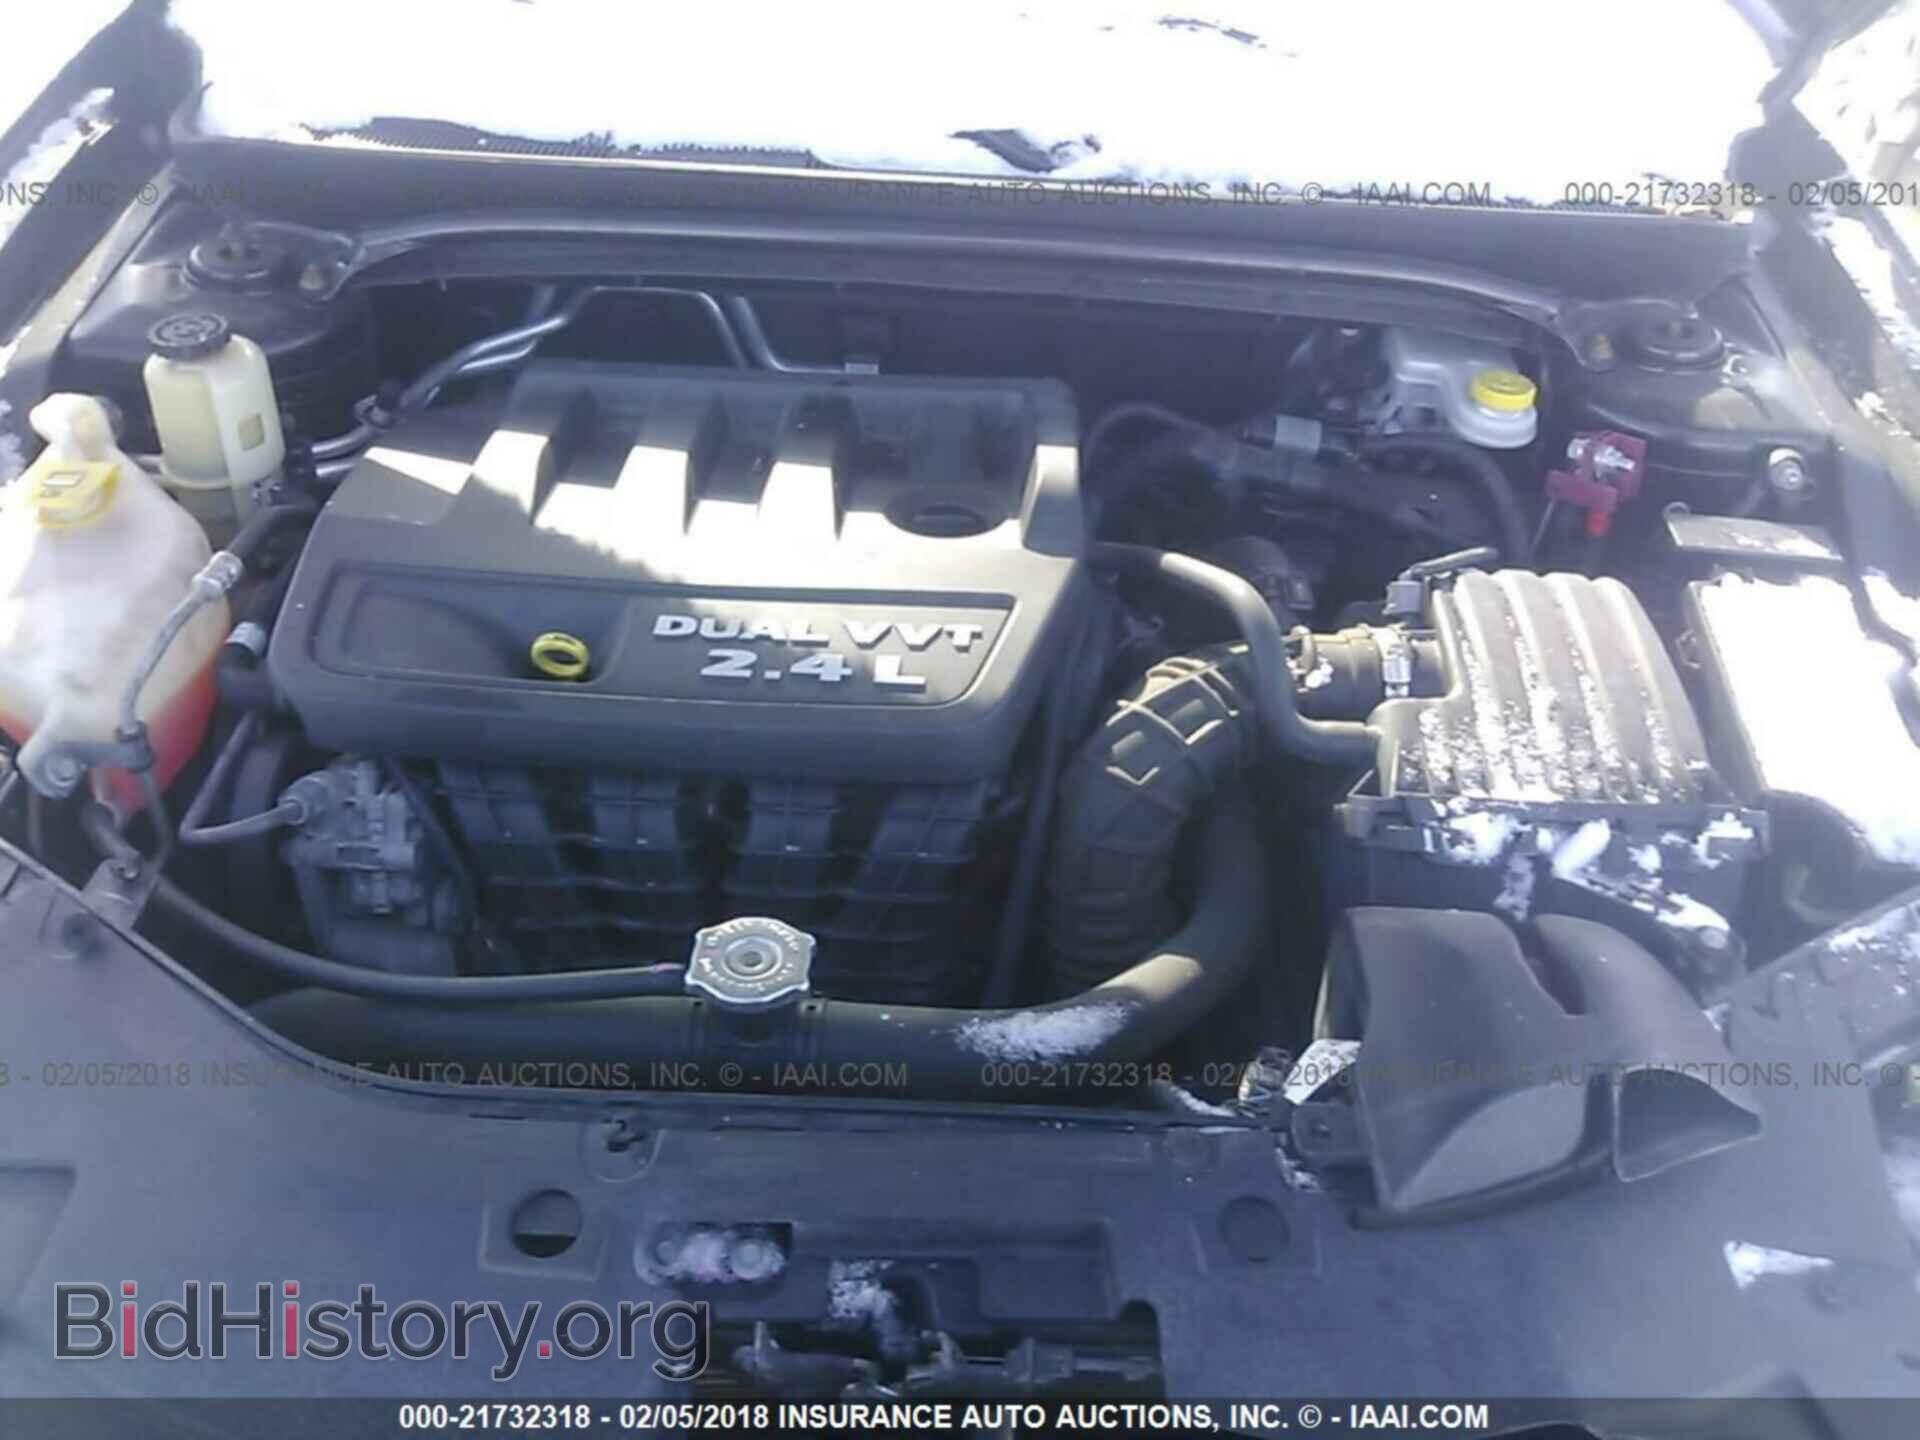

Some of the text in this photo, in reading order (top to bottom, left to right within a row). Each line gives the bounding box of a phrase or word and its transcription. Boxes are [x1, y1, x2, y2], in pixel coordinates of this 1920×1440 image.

[651, 613, 985, 652] DUAL VVT
[700, 648, 927, 692] 2.4 L
